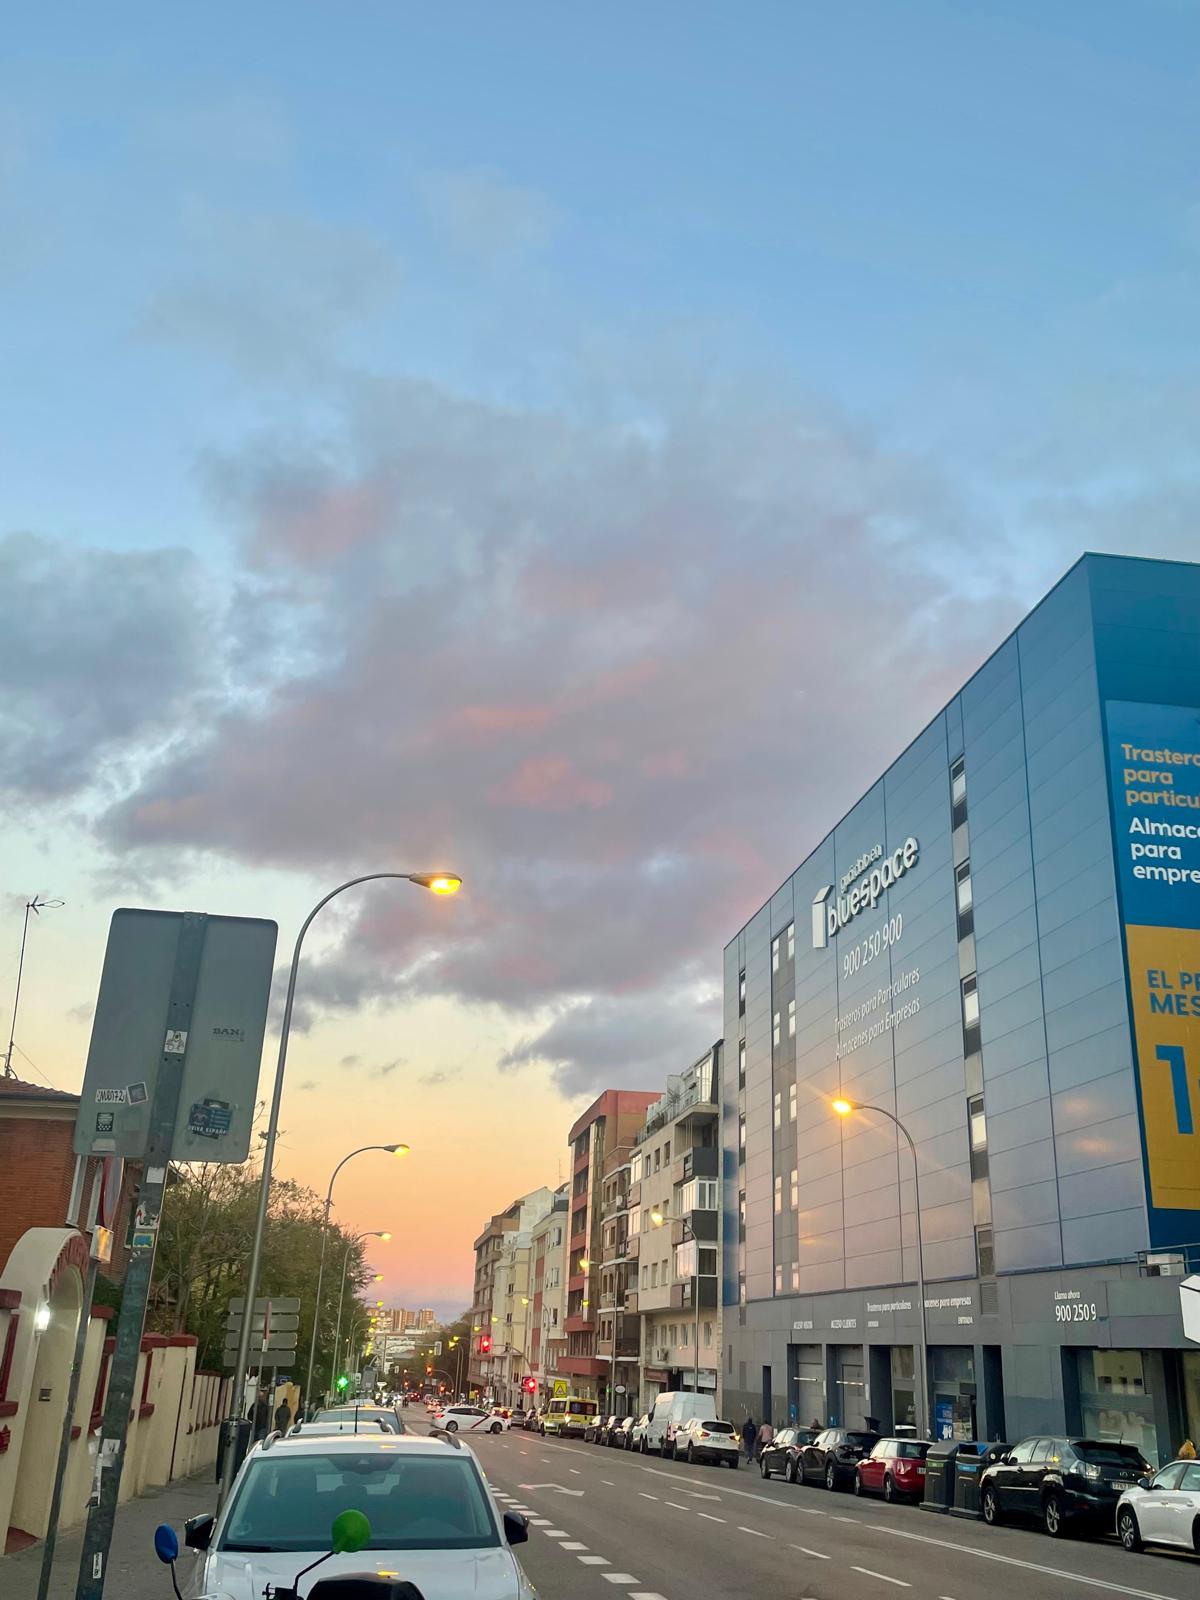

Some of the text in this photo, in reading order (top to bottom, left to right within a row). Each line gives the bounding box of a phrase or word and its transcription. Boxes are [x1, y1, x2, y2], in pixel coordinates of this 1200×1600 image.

[1124, 768, 1174, 785] para
[1129, 817, 1200, 839] Almac
[1131, 843, 1182, 860] para
[828, 837, 918, 937] bluespace
[843, 912, 903, 980] 900 250 900
[1147, 969, 1173, 989] EL
[861, 996, 877, 1021] para
[877, 967, 920, 1007] Particulares
[1149, 992, 1200, 1017] MES
[868, 1019, 884, 1045] para
[885, 997, 920, 1031] Empresas
[1155, 1044, 1194, 1135] 1
[1055, 1304, 1071, 1322] 900
[1072, 1303, 1089, 1322] 250
